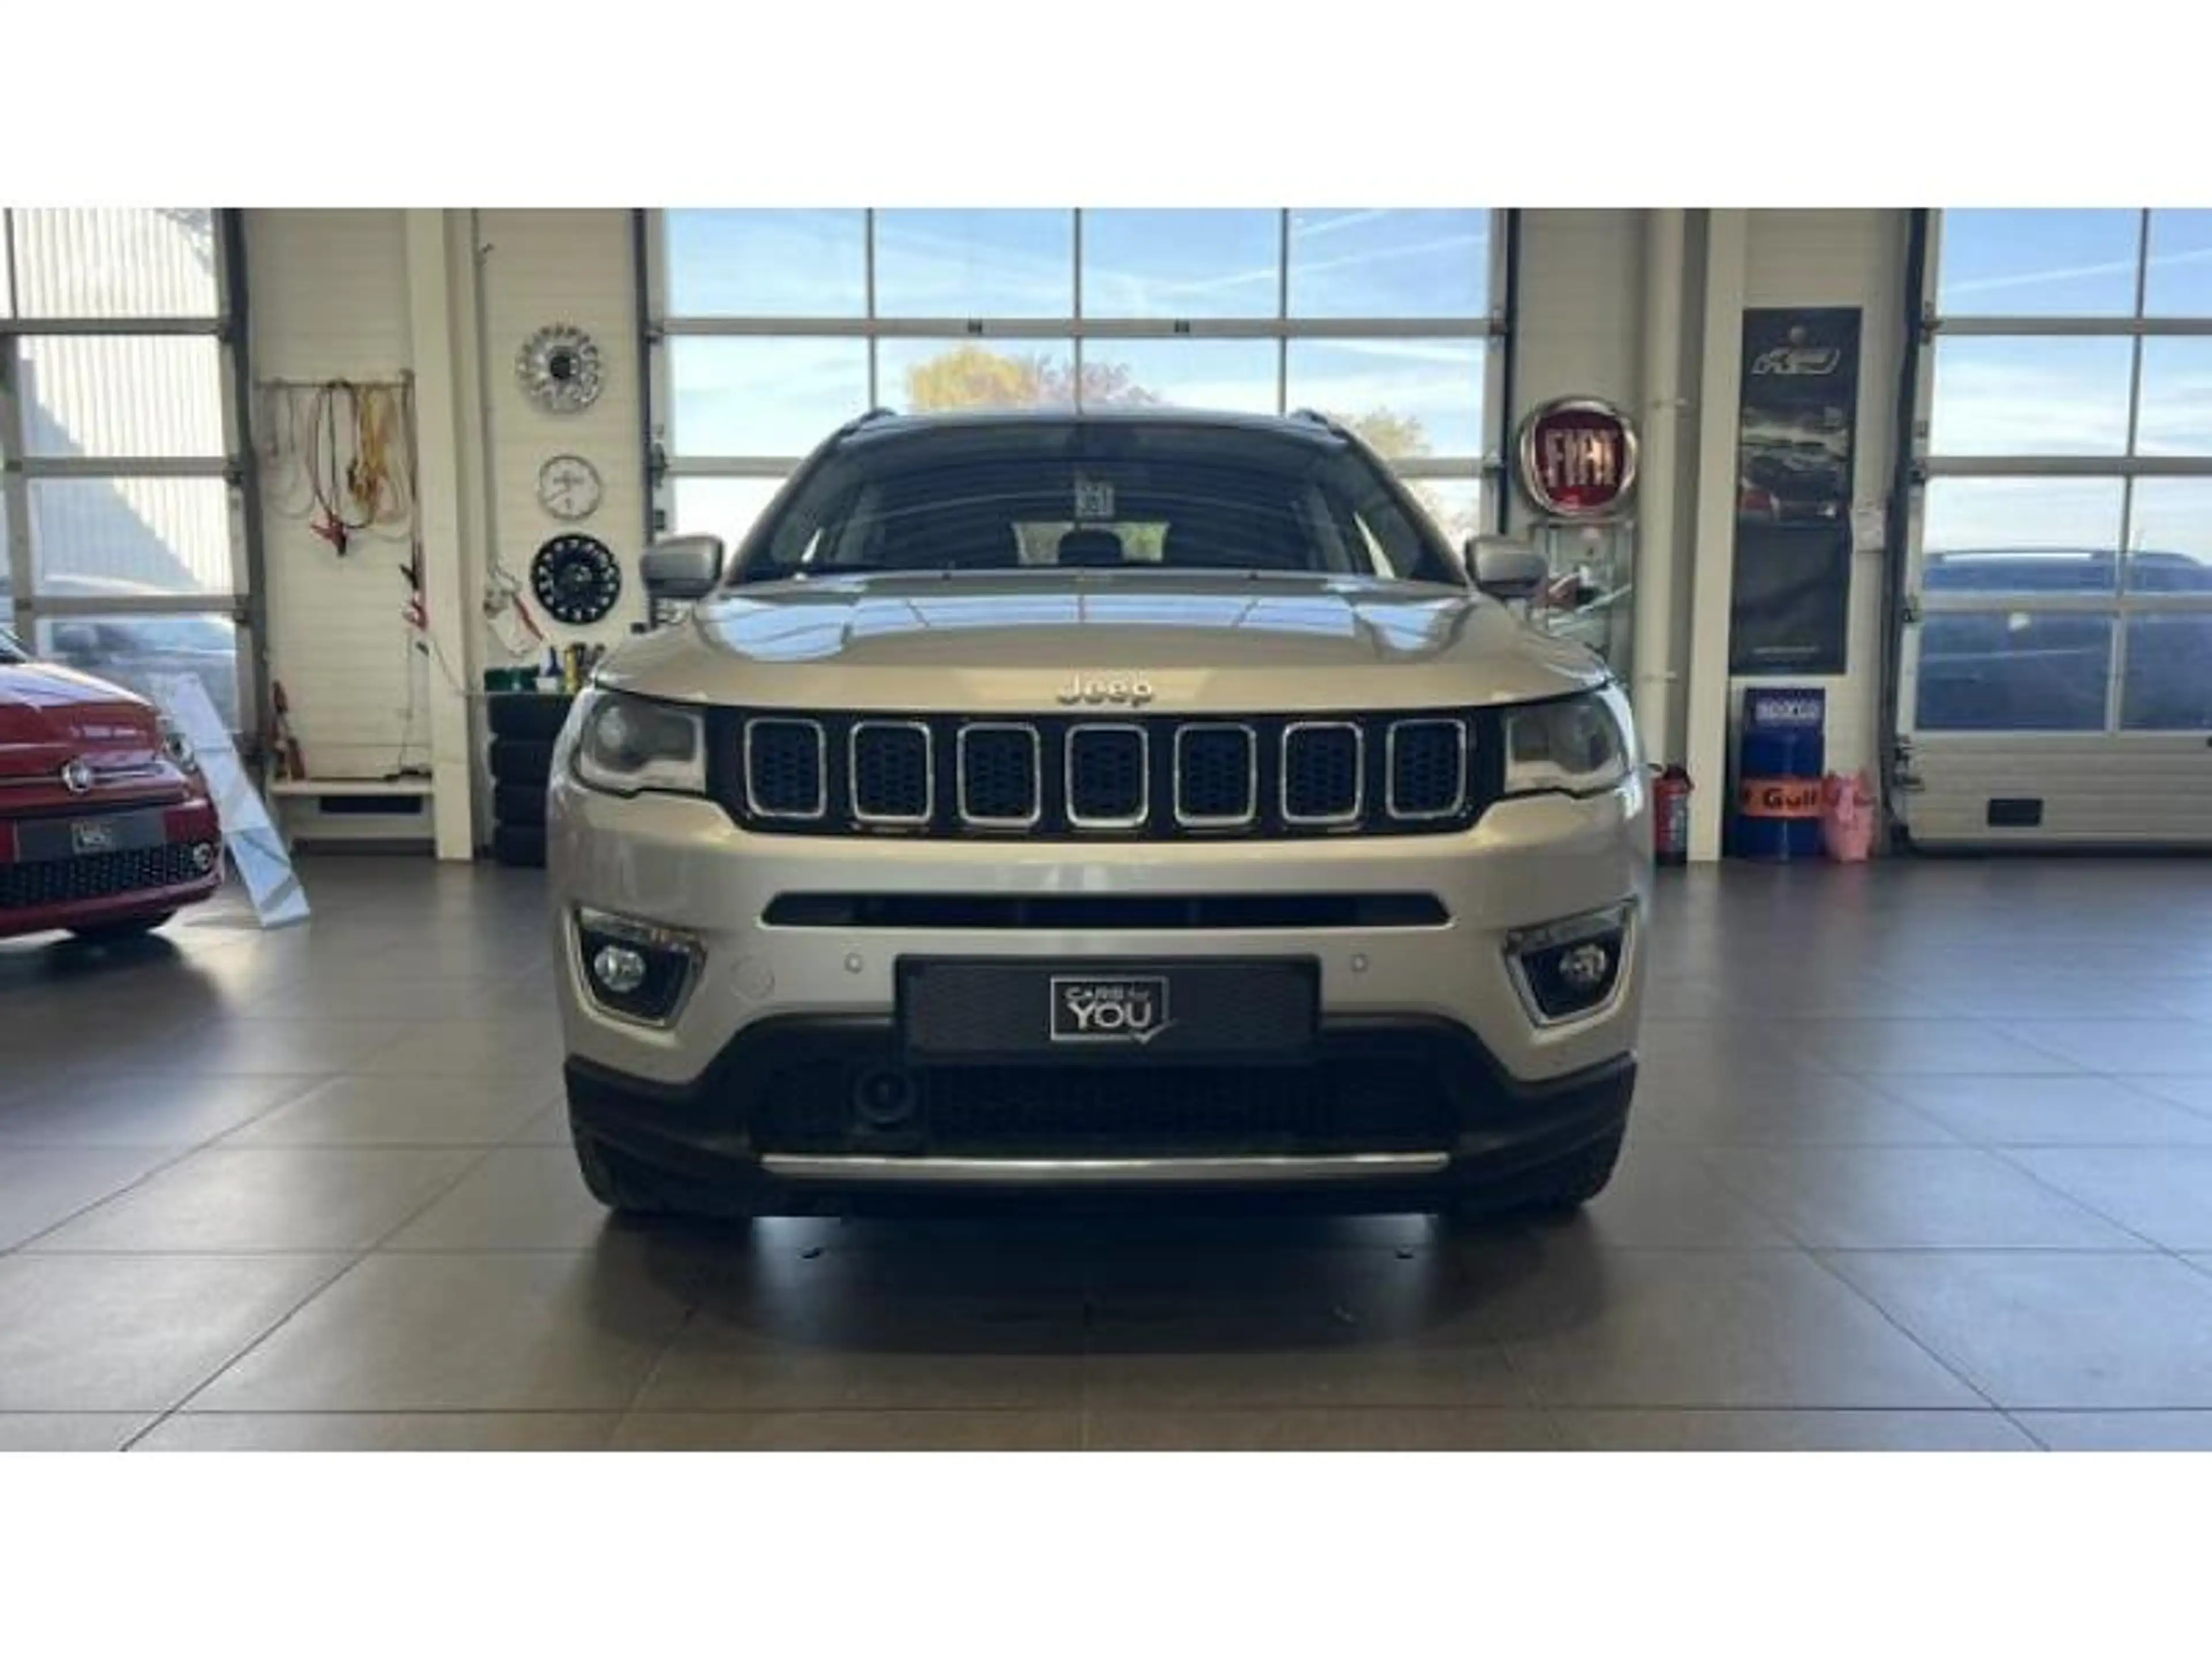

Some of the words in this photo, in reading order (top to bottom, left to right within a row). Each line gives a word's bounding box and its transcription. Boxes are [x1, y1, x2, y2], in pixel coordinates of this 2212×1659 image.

[1545, 428, 1619, 487] FIAT
[1057, 671, 1154, 706] Jeep
[1067, 1001, 1151, 1030] YOU
